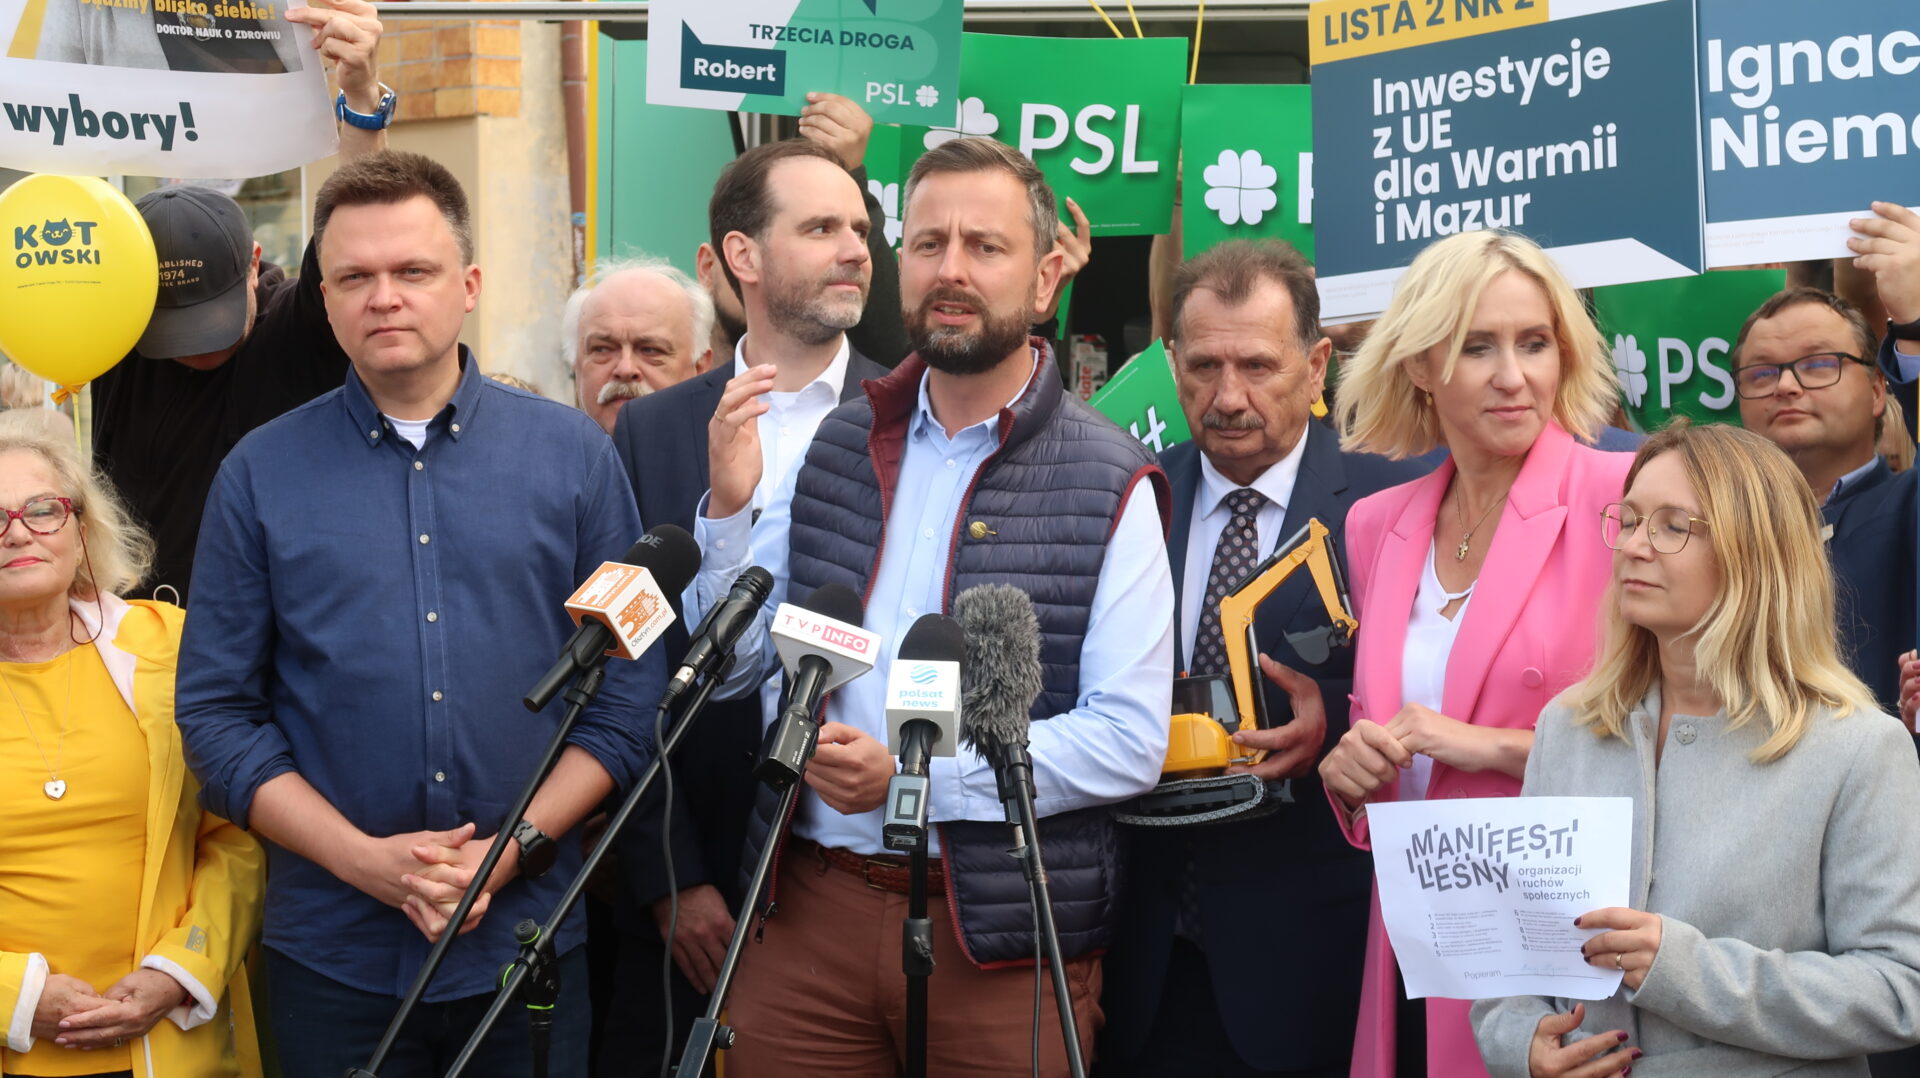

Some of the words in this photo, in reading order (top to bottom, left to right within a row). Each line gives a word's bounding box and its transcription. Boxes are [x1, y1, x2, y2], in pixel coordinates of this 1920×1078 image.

[155, 0, 208, 15] blisko
[214, 0, 277, 20] siebie!
[156, 24, 193, 36] DOKTOR
[195, 28, 222, 38] NAUK
[225, 30, 232, 38] O
[235, 30, 280, 39] ZDROWIU
[1324, 1, 1416, 46] LISTA
[1425, 0, 1445, 27] 2
[1455, 0, 1504, 22] NR
[749, 24, 834, 45] TRZECIA
[840, 30, 914, 51] DROGA
[693, 58, 776, 82] Robert
[1373, 38, 1611, 116] Inwestycje
[1707, 30, 1920, 109] Ignac
[865, 82, 911, 106] PSL
[3, 93, 199, 151] wybory!
[1373, 126, 1393, 159] z
[1402, 109, 1453, 153] UE
[1018, 103, 1160, 176] PSL
[1709, 105, 1920, 171] Niem
[1373, 157, 1440, 200] dla
[1451, 122, 1618, 189] Warmii
[1375, 202, 1386, 244] i
[1396, 192, 1531, 242] Mazur
[15, 249, 101, 269] OWSKI
[160, 260, 204, 269] ABLISHED
[160, 269, 185, 280] 1974
[1658, 336, 1735, 410] PS
[825, 627, 867, 652] INFO
[898, 689, 943, 699] polsat
[902, 700, 939, 708] news
[1518, 865, 1582, 878] organizacji
[1522, 877, 1564, 888] ruchów
[1523, 890, 1590, 902] społecznych
